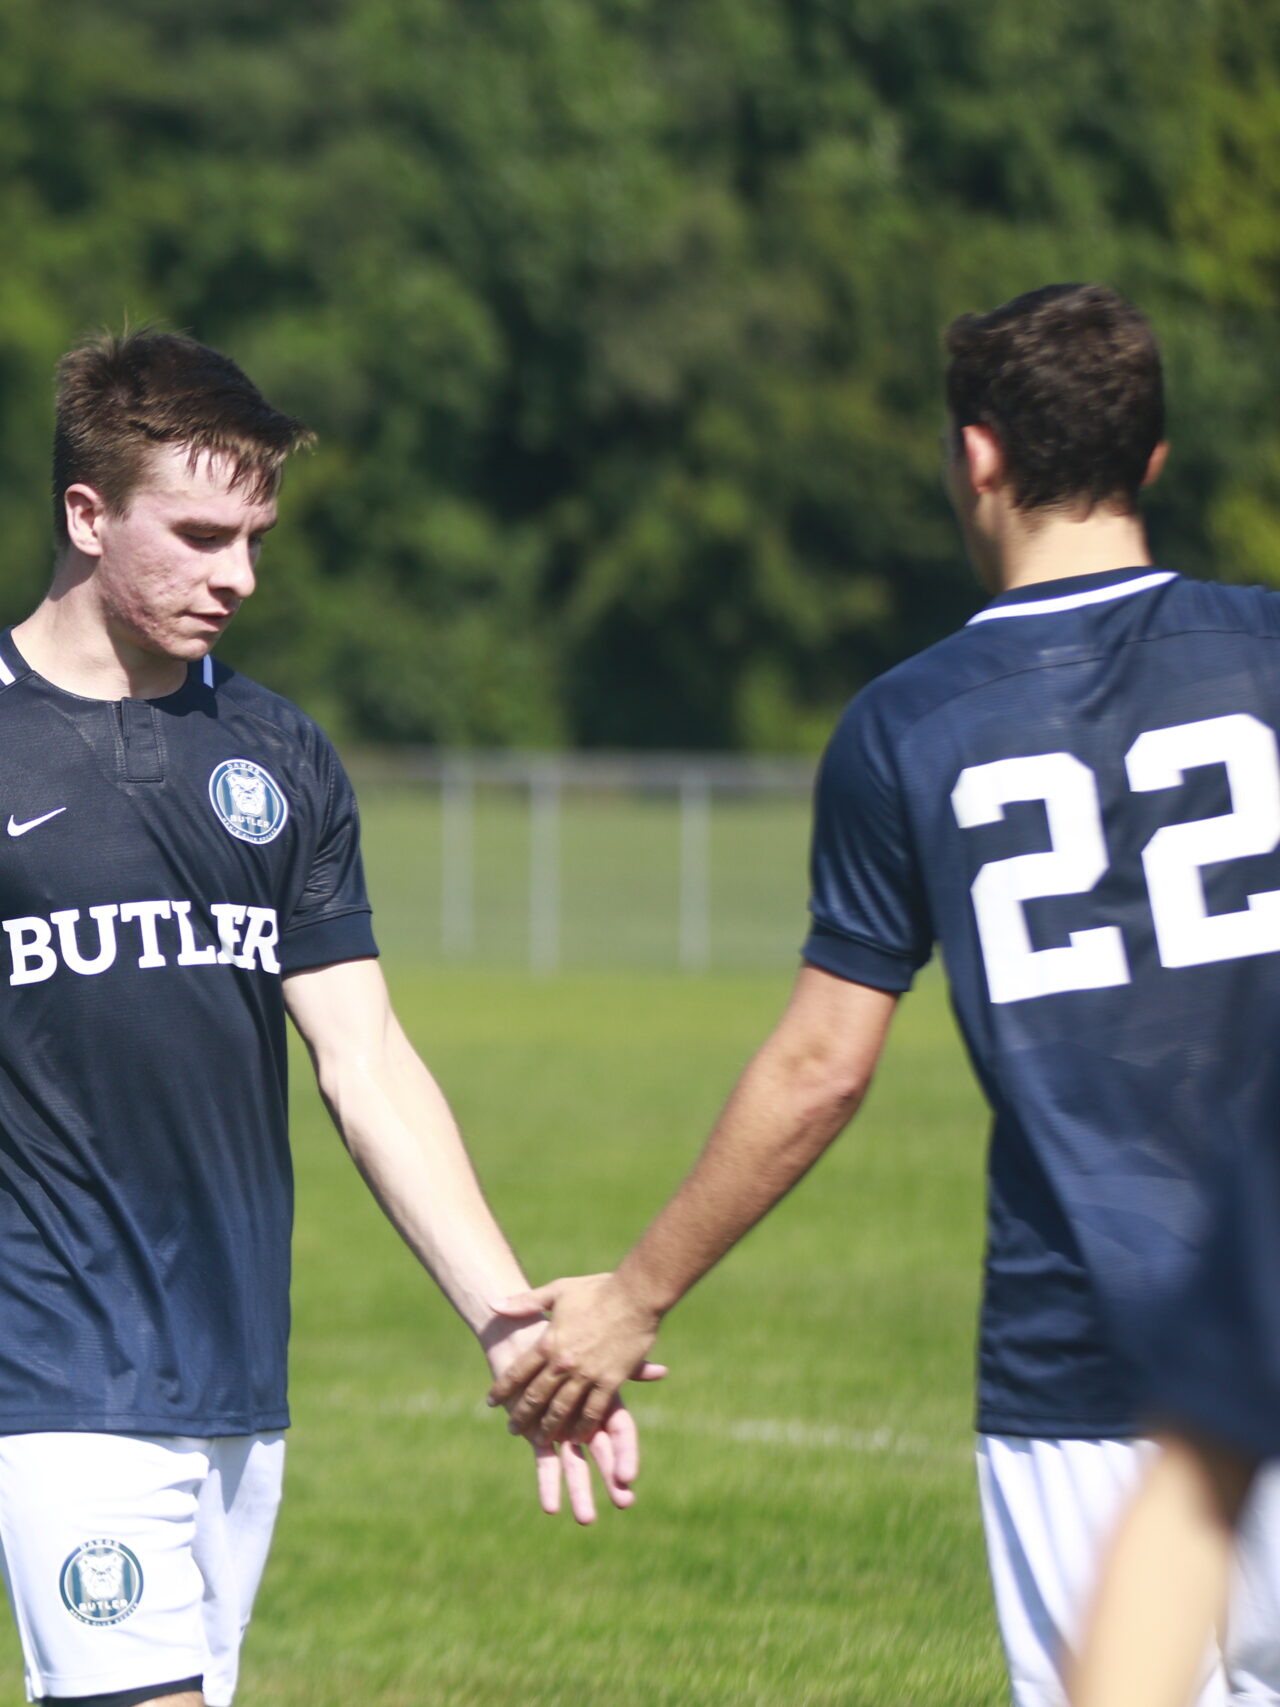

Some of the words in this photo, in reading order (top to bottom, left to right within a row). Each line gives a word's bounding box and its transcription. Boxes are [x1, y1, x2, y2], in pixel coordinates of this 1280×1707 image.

[230, 814, 270, 829] BUTLER
[951, 713, 1280, 1004] 22
[2, 900, 280, 986] BUTLER
[78, 1598, 128, 1612] BUTLER
